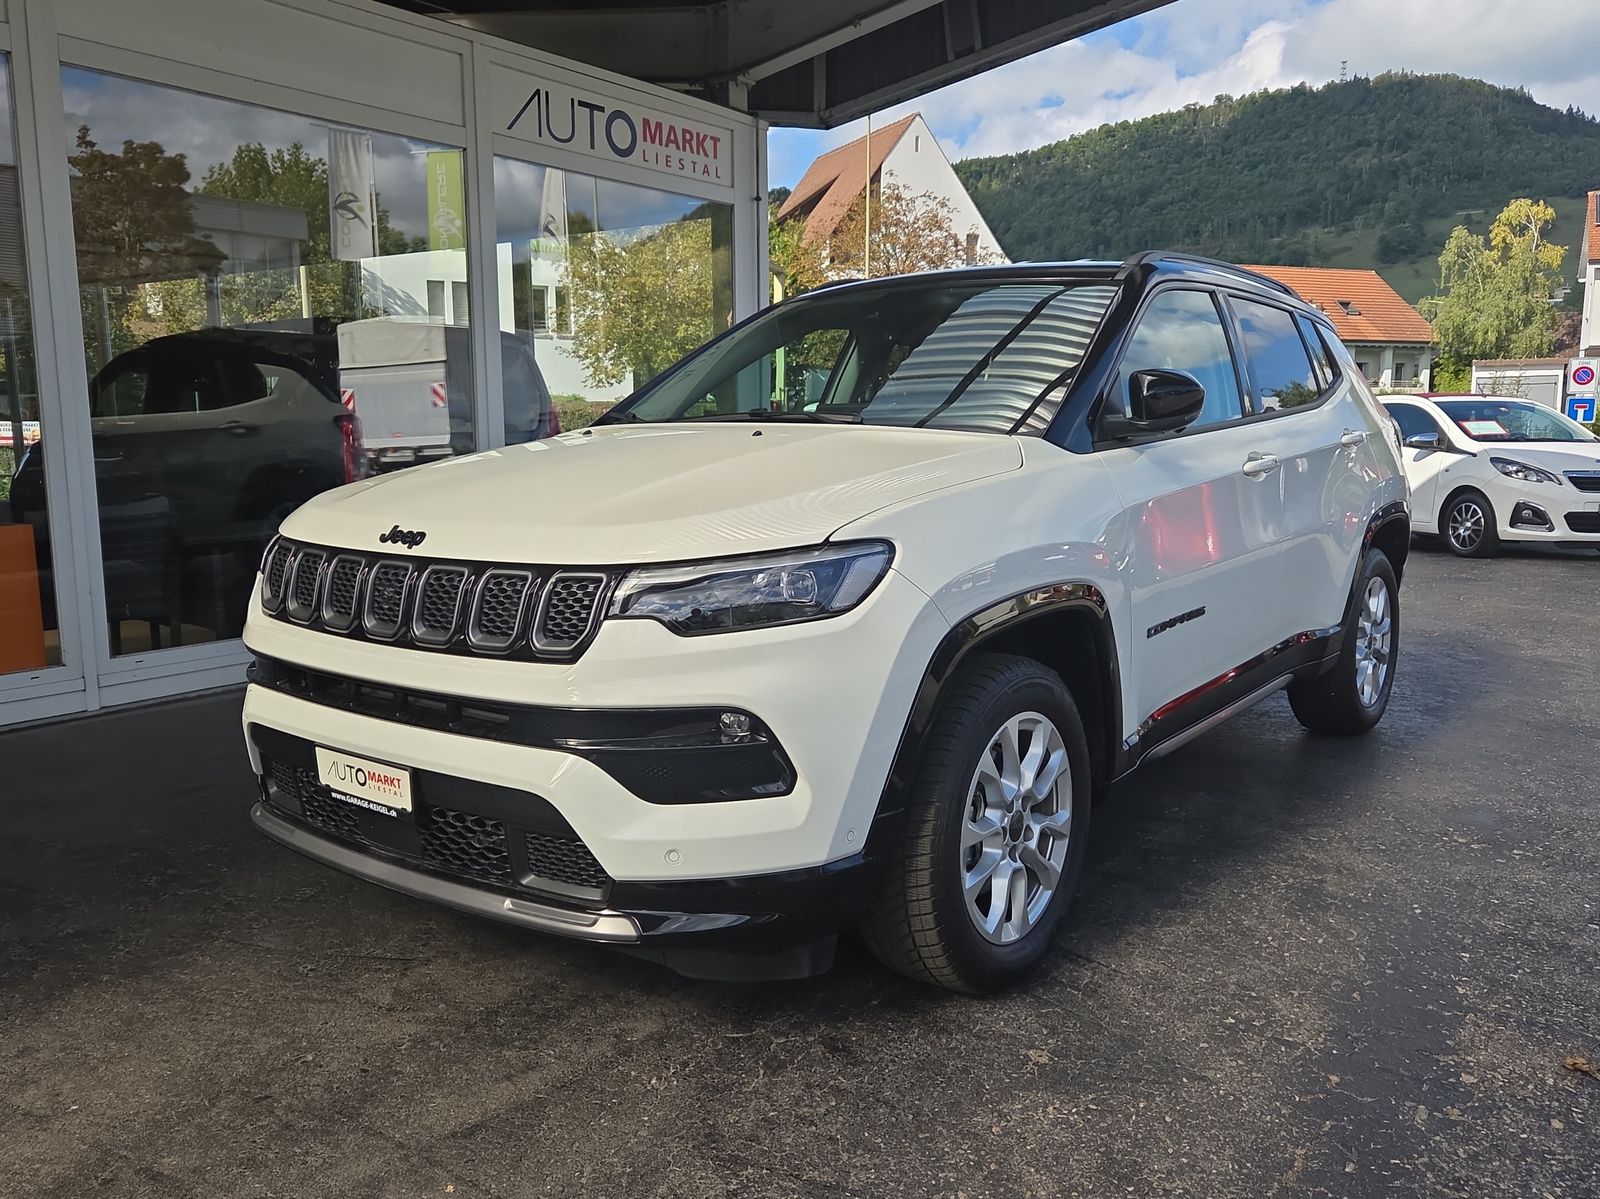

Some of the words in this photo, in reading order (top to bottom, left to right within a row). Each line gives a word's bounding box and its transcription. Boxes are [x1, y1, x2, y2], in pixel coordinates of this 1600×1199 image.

[506, 88, 637, 158] AUTO
[642, 117, 721, 160] MARKT
[642, 149, 721, 179] LIESTAL
[379, 525, 427, 549] Jeep
[327, 760, 367, 787] AUTO
[367, 770, 402, 789] MARKT
[368, 783, 403, 798] LIESTAL
